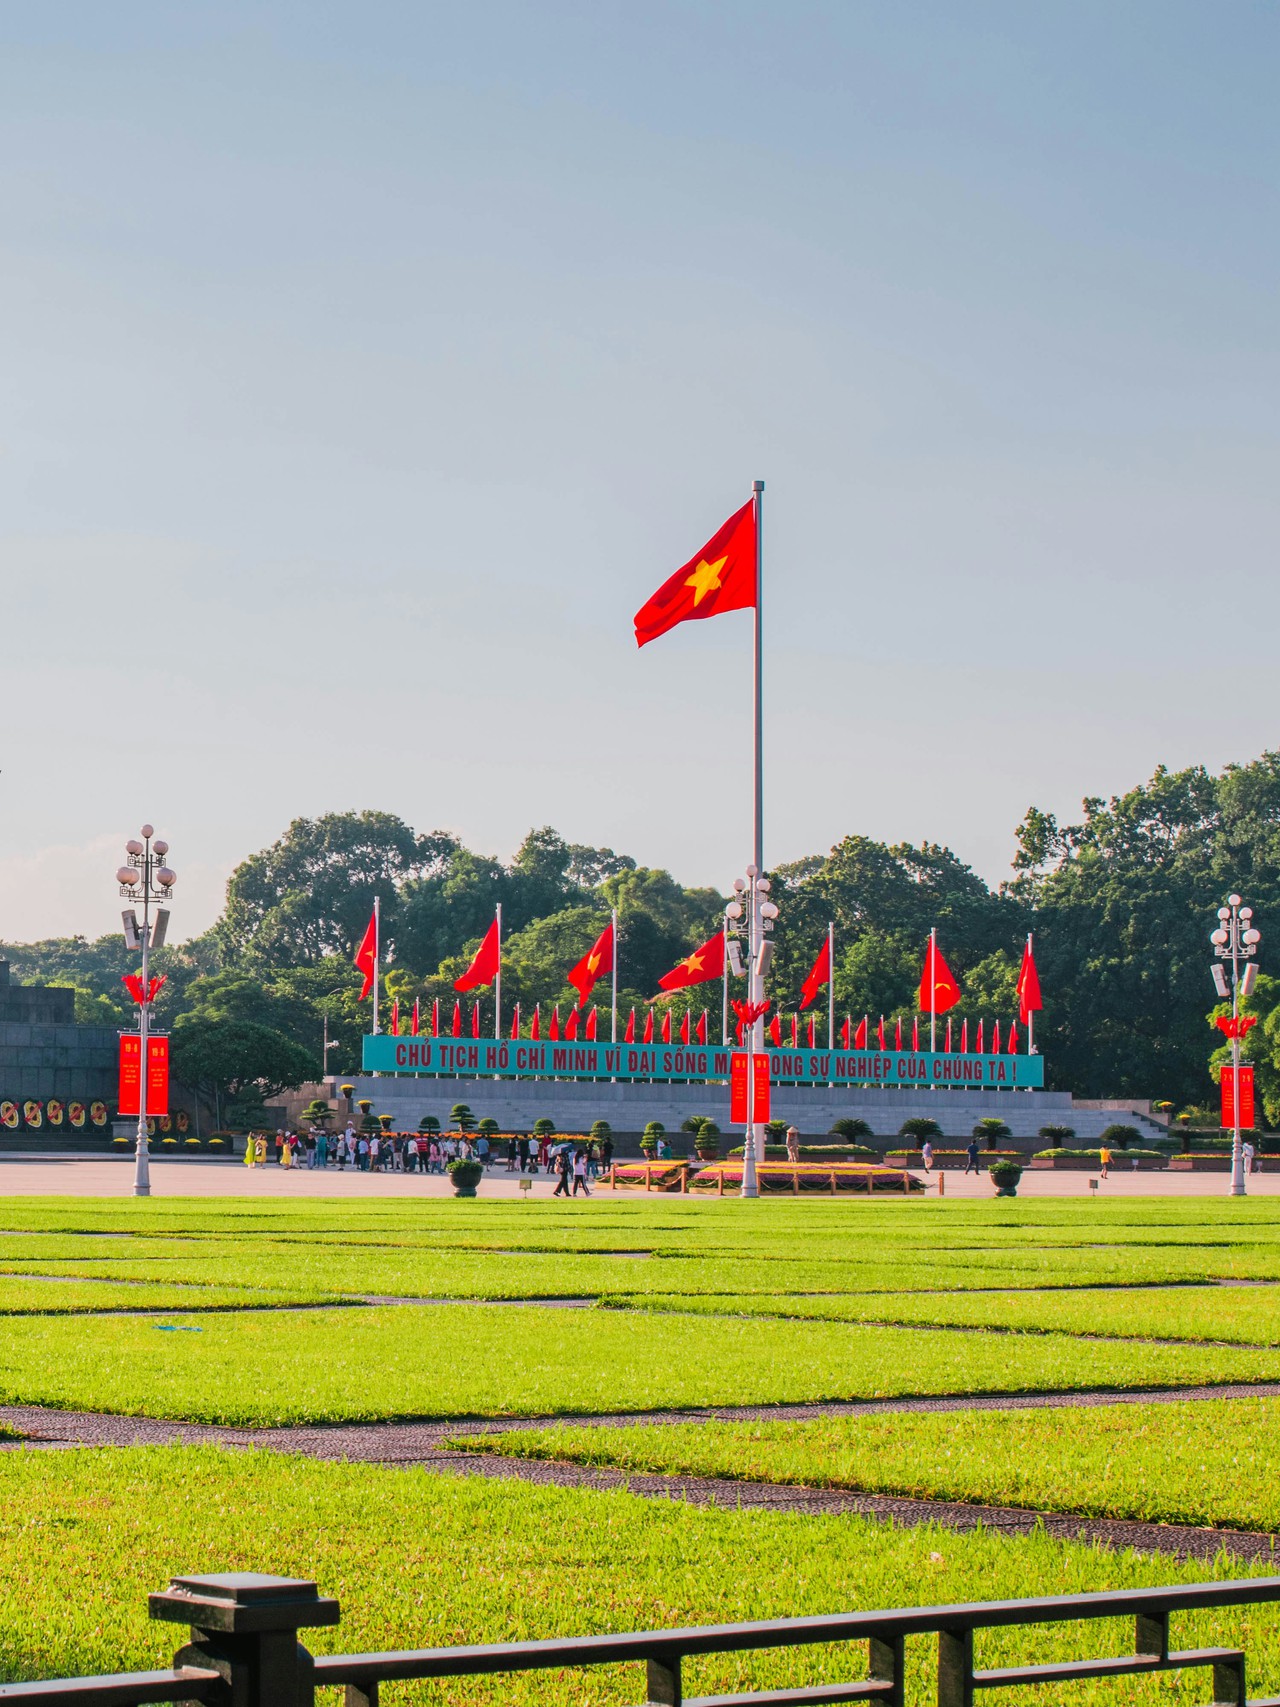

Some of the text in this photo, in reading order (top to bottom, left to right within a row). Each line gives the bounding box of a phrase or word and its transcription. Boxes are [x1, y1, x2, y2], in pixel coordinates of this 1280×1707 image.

[396, 1038, 432, 1067] CHỦ
[440, 1045, 478, 1072] TỊCH
[486, 1040, 509, 1069] HỒ
[516, 1044, 545, 1070] CHÍ
[553, 1048, 597, 1071] MINH
[605, 1046, 622, 1072] VĨ
[628, 1050, 656, 1076] ĐẠI
[663, 1046, 707, 1074] SỐNG
[771, 1055, 803, 1076] ONG
[809, 1053, 831, 1081] SỰ
[836, 1054, 892, 1082] NGHIỆP
[897, 1053, 927, 1080] CỦA
[933, 1055, 983, 1081] CHÚNG
[988, 1061, 1006, 1081] TA
